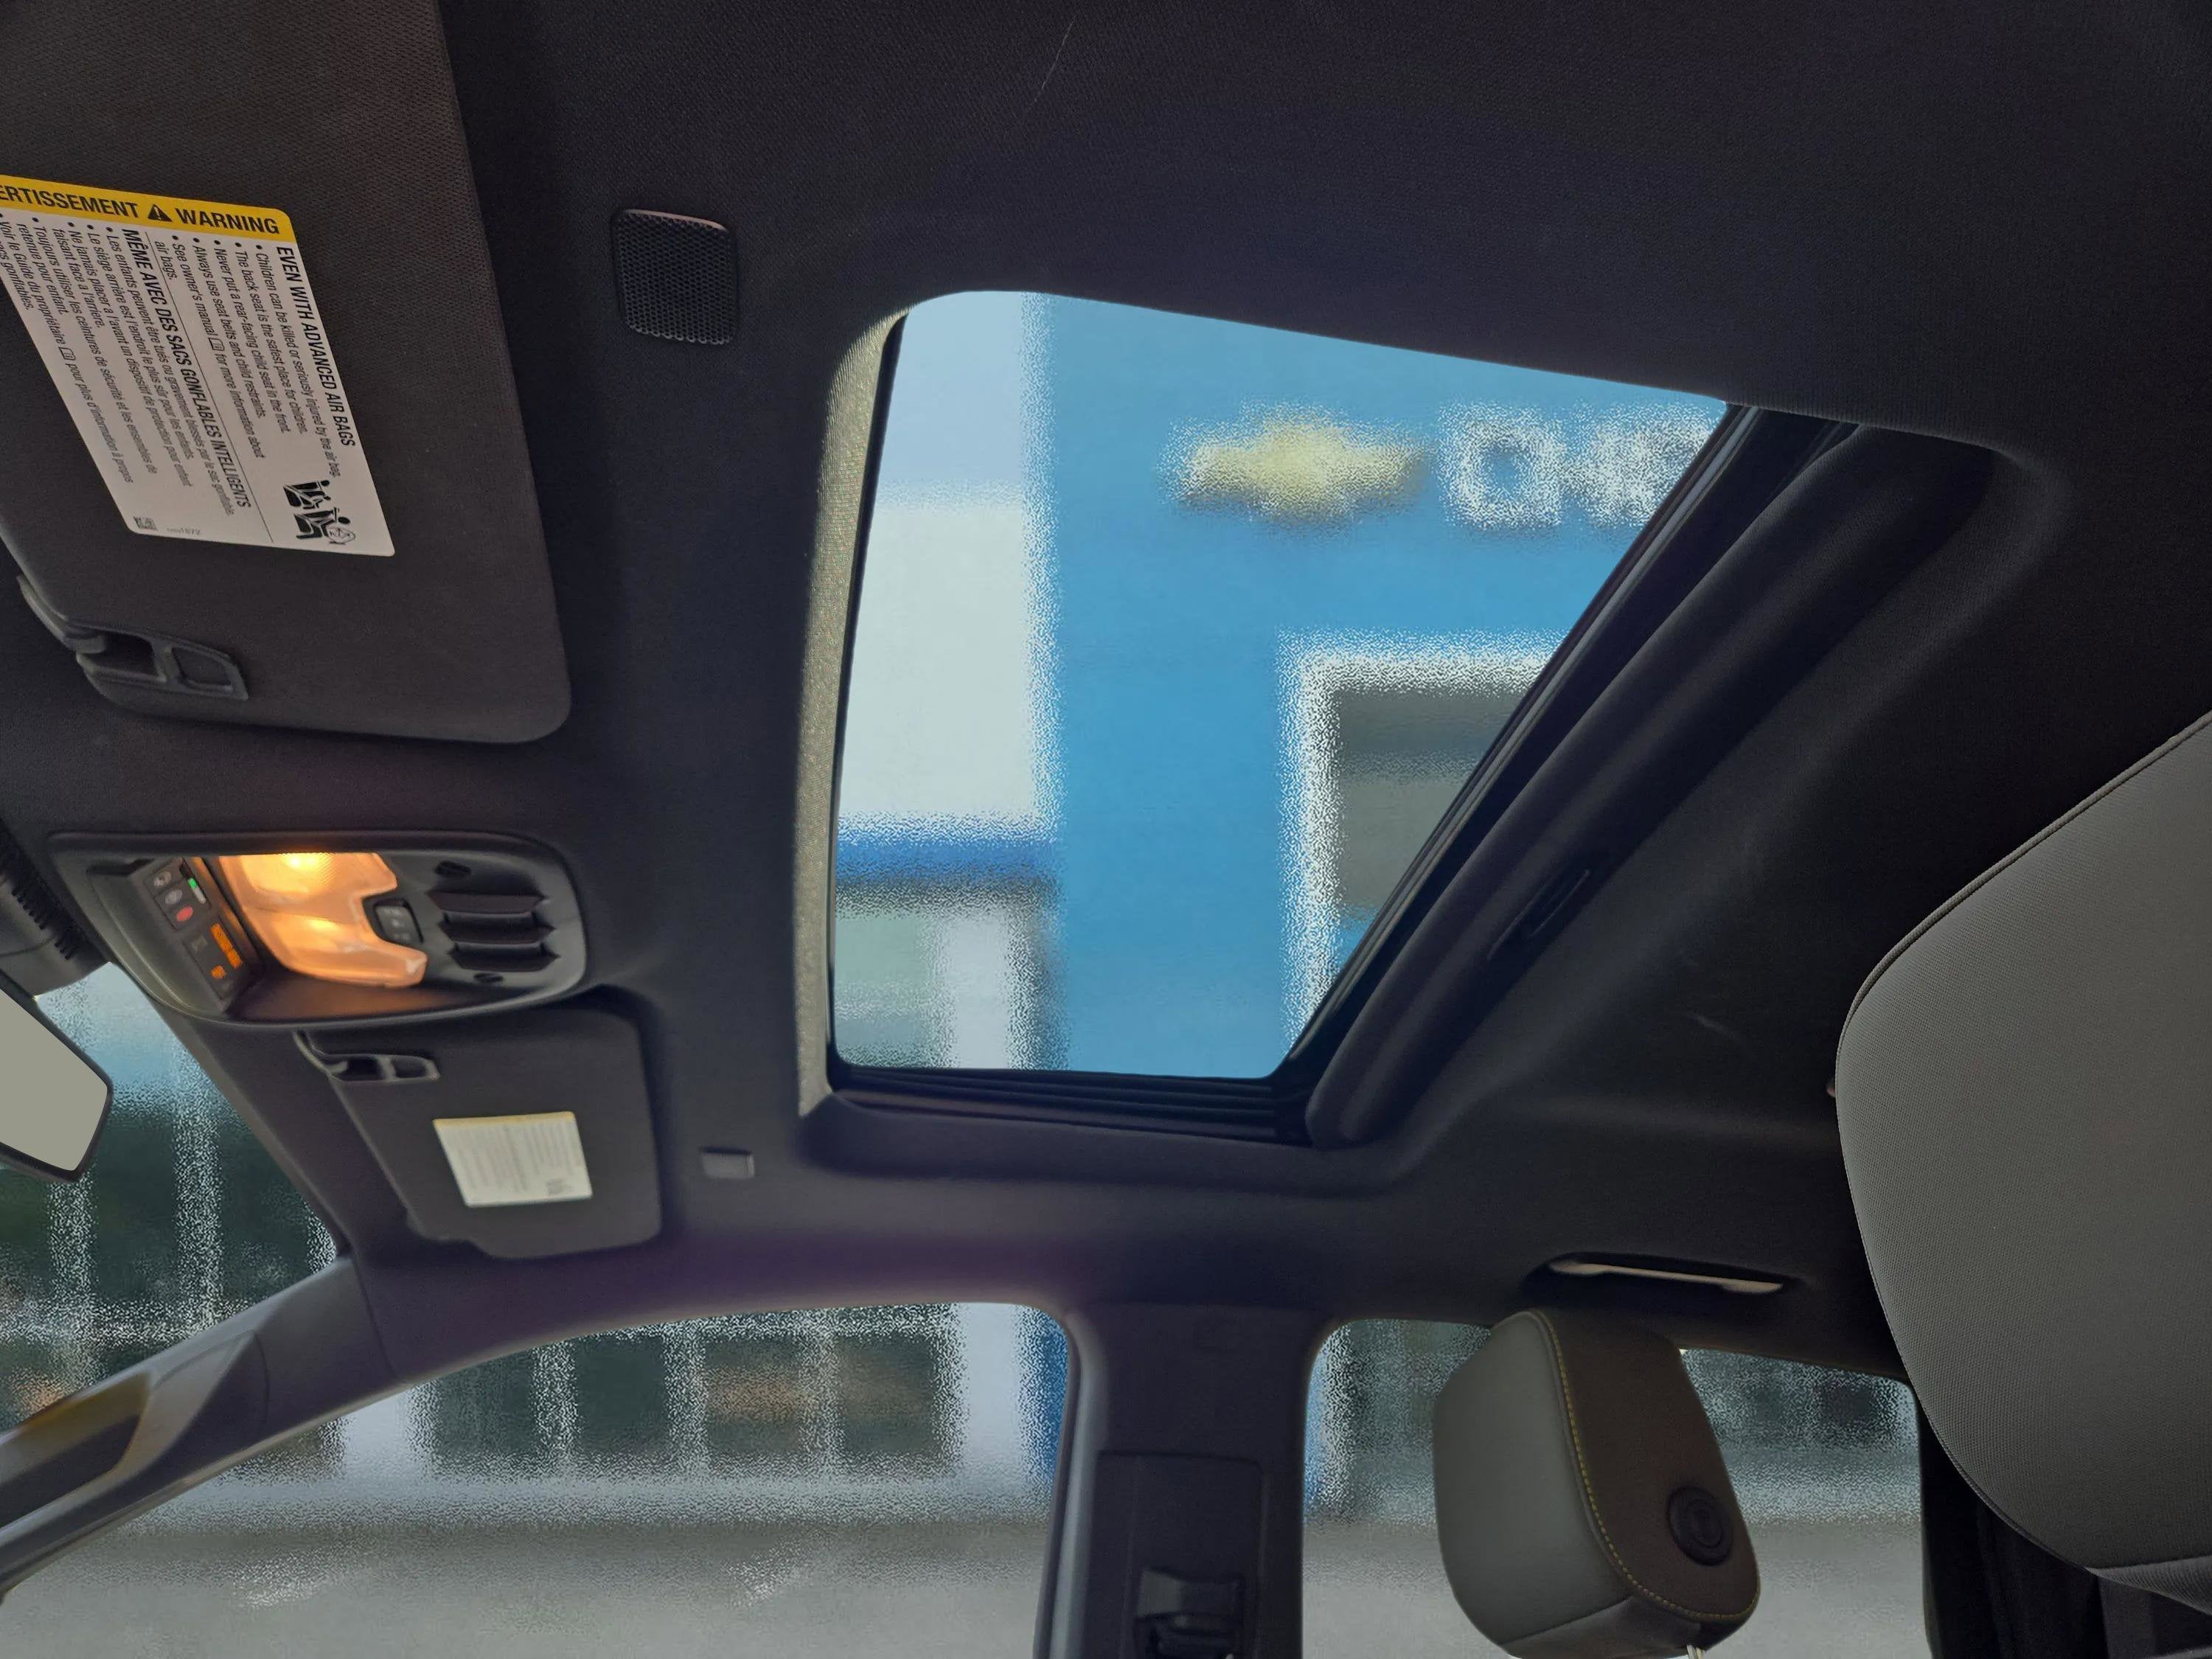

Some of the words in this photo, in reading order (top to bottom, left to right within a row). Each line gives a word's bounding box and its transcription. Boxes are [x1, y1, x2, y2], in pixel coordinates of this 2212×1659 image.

[0, 221, 16, 240] Voir
[175, 207, 280, 234] WARNING
[32, 226, 60, 266] Toujours
[67, 230, 83, 244] Ne
[121, 229, 154, 270] MÊME
[154, 240, 170, 255] air
[52, 228, 77, 261] faisant
[67, 262, 86, 282] face
[72, 244, 98, 276] jamais
[93, 246, 113, 272] siège
[172, 243, 187, 262] See
[192, 245, 214, 279] Always
[213, 248, 233, 276] Never
[234, 251, 249, 268] The
[276, 246, 303, 282] EVEN
[13, 253, 35, 279] Guide
[15, 223, 42, 260] retenue
[32, 261, 54, 283] pour
[46, 285, 70, 315] enfant.
[159, 256, 178, 280] bags.
[1, 262, 34, 310] gonflables.
[52, 268, 76, 300] utiliser
[87, 278, 111, 307] placer
[105, 273, 127, 304] arrière
[142, 272, 168, 305] AVEC
[179, 263, 204, 302] owner's
[205, 280, 220, 297] use
[221, 276, 240, 293] put
[240, 269, 260, 292] back
[68, 301, 83, 314] les
[105, 234, 122, 252] Les
[114, 254, 138, 288] enfants
[127, 289, 155, 325] peuvent
[145, 326, 161, 344] être
[153, 345, 170, 364] tués
[119, 305, 136, 319] est
[212, 298, 230, 318] seat
[249, 293, 267, 313] seat
[289, 286, 316, 320] WITH
[30, 294, 66, 345] propriétaire
[106, 315, 130, 344] l'avant
[154, 307, 179, 332] DES
[195, 302, 218, 336] manual
[220, 319, 237, 340] belts
[232, 301, 259, 349] rear-facing
[260, 324, 274, 338] the
[75, 316, 102, 355] ceintures
[125, 320, 151, 355] l'endroit
[255, 252, 277, 291] Children
[268, 293, 284, 310] can
[279, 324, 299, 349] killed
[292, 360, 314, 397] seriously
[305, 398, 326, 426] injured
[166, 334, 192, 366] SACS
[214, 353, 229, 366] for
[229, 341, 246, 358] and
[251, 349, 269, 370] child
[265, 338, 285, 365] safest
[301, 322, 338, 389] ADVANCED
[64, 363, 85, 383] pour
[143, 366, 161, 383] plus
[219, 366, 237, 389] more
[235, 358, 254, 379] child
[258, 371, 276, 390] seat
[273, 365, 292, 388] place
[74, 383, 94, 401] plus
[180, 368, 223, 438] GONFLABLES
[324, 392, 345, 413] AIR
[158, 399, 176, 418] pour
[269, 399, 282, 412] the
[333, 415, 356, 446] BAGS
[163, 445, 181, 464] pour
[210, 439, 251, 508] INTELLIGENTS
